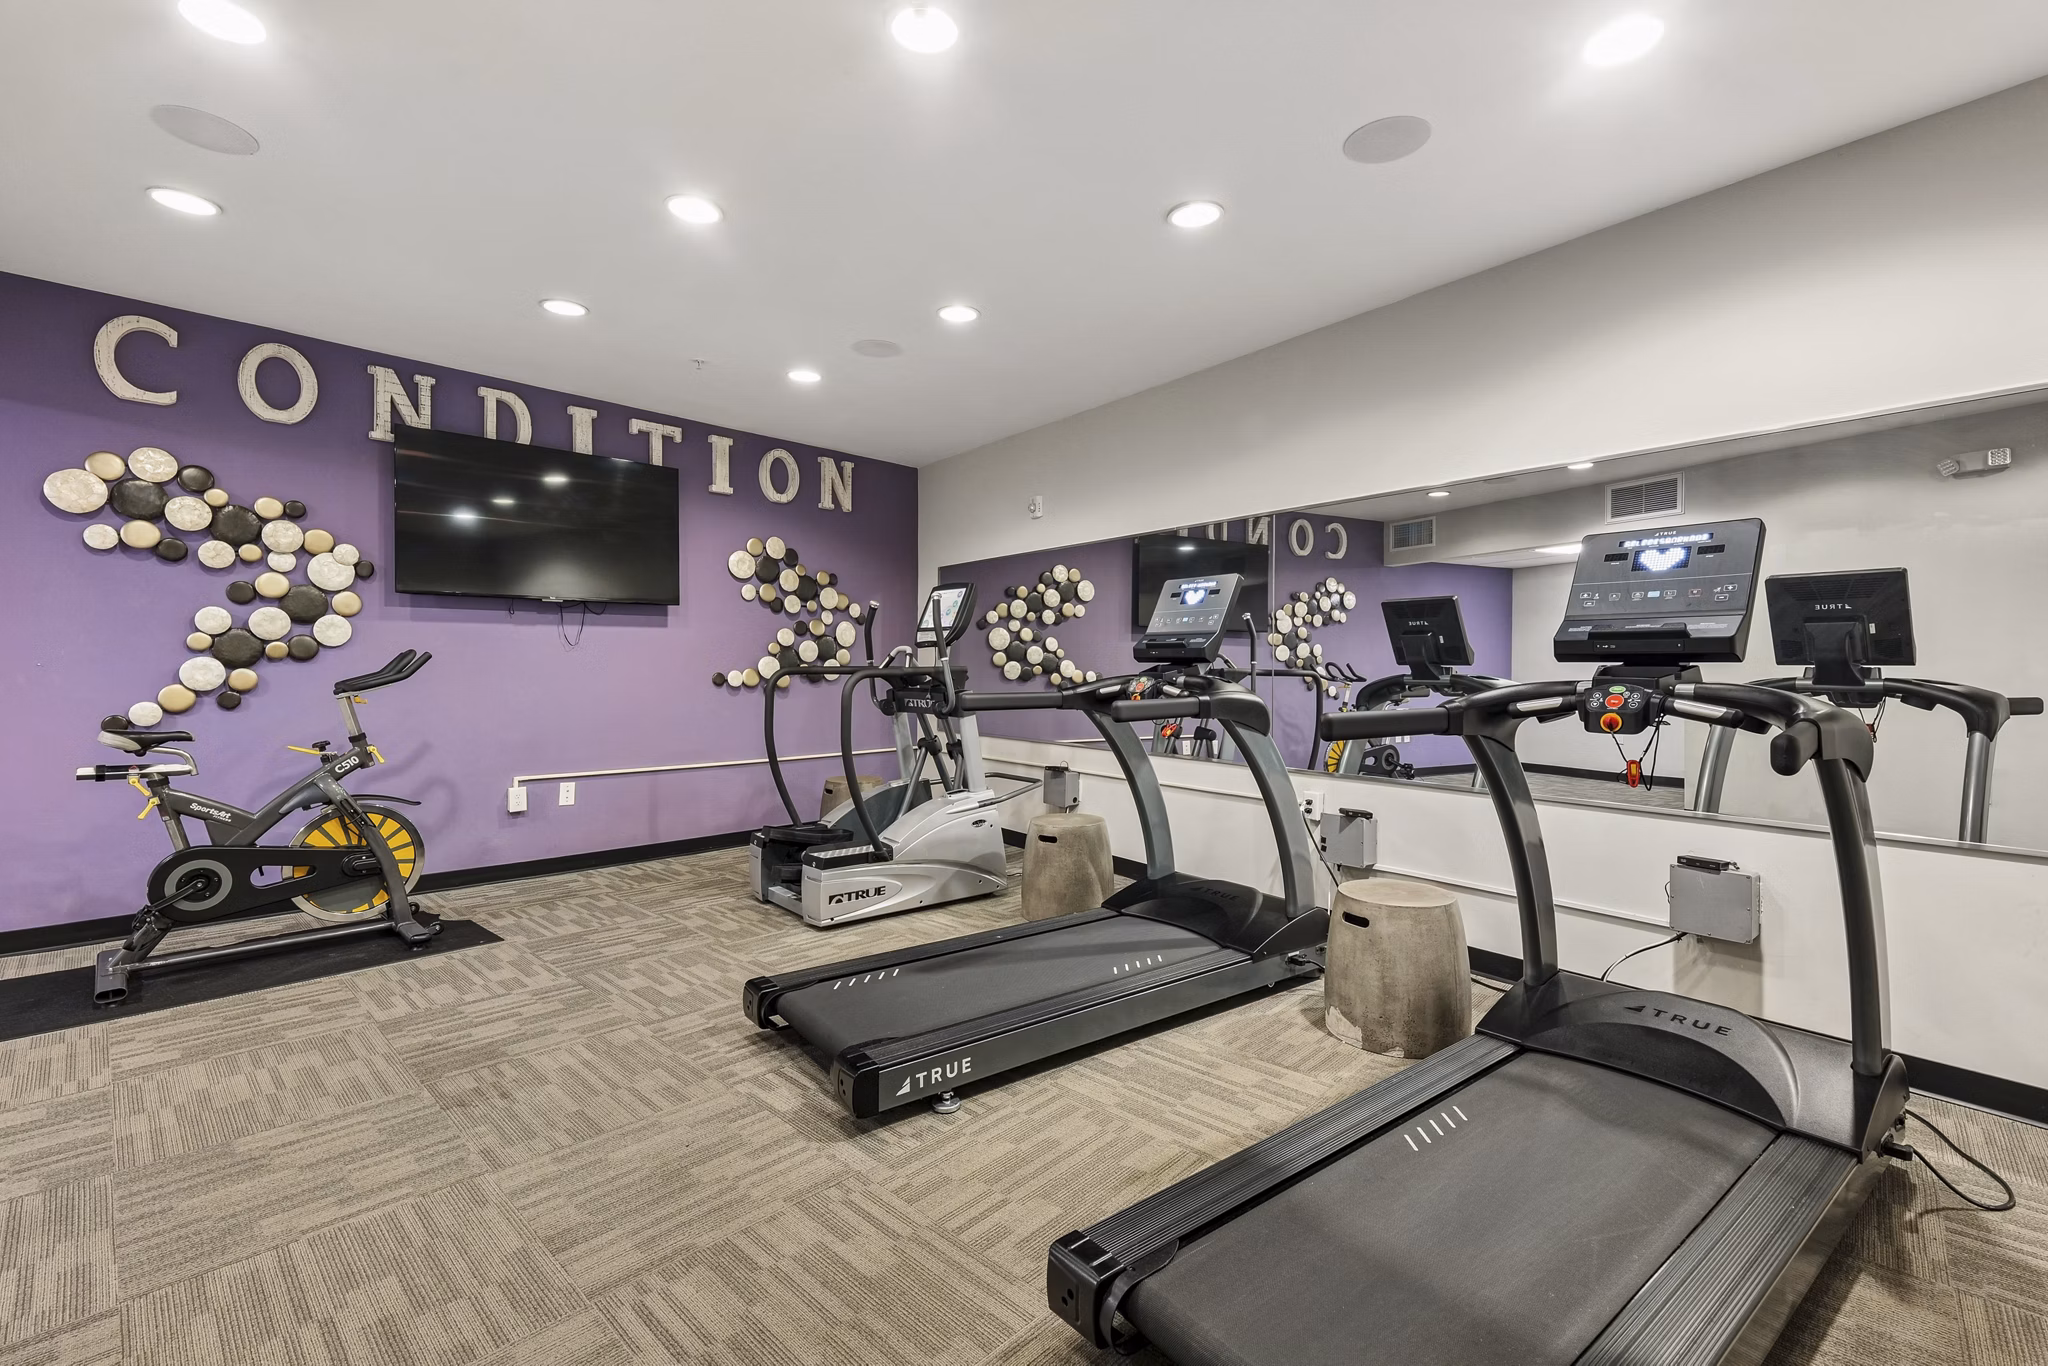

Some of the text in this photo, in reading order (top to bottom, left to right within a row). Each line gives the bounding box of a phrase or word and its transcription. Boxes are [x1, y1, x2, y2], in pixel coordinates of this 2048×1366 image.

[93, 315, 857, 513] CONDITION
[913, 699, 936, 708] TRU
[334, 755, 360, 774] C510
[189, 802, 232, 819] SportsArt
[843, 885, 886, 902] TRUE
[1653, 1008, 1732, 1037] TRUE
[915, 1057, 972, 1089] TRUE
